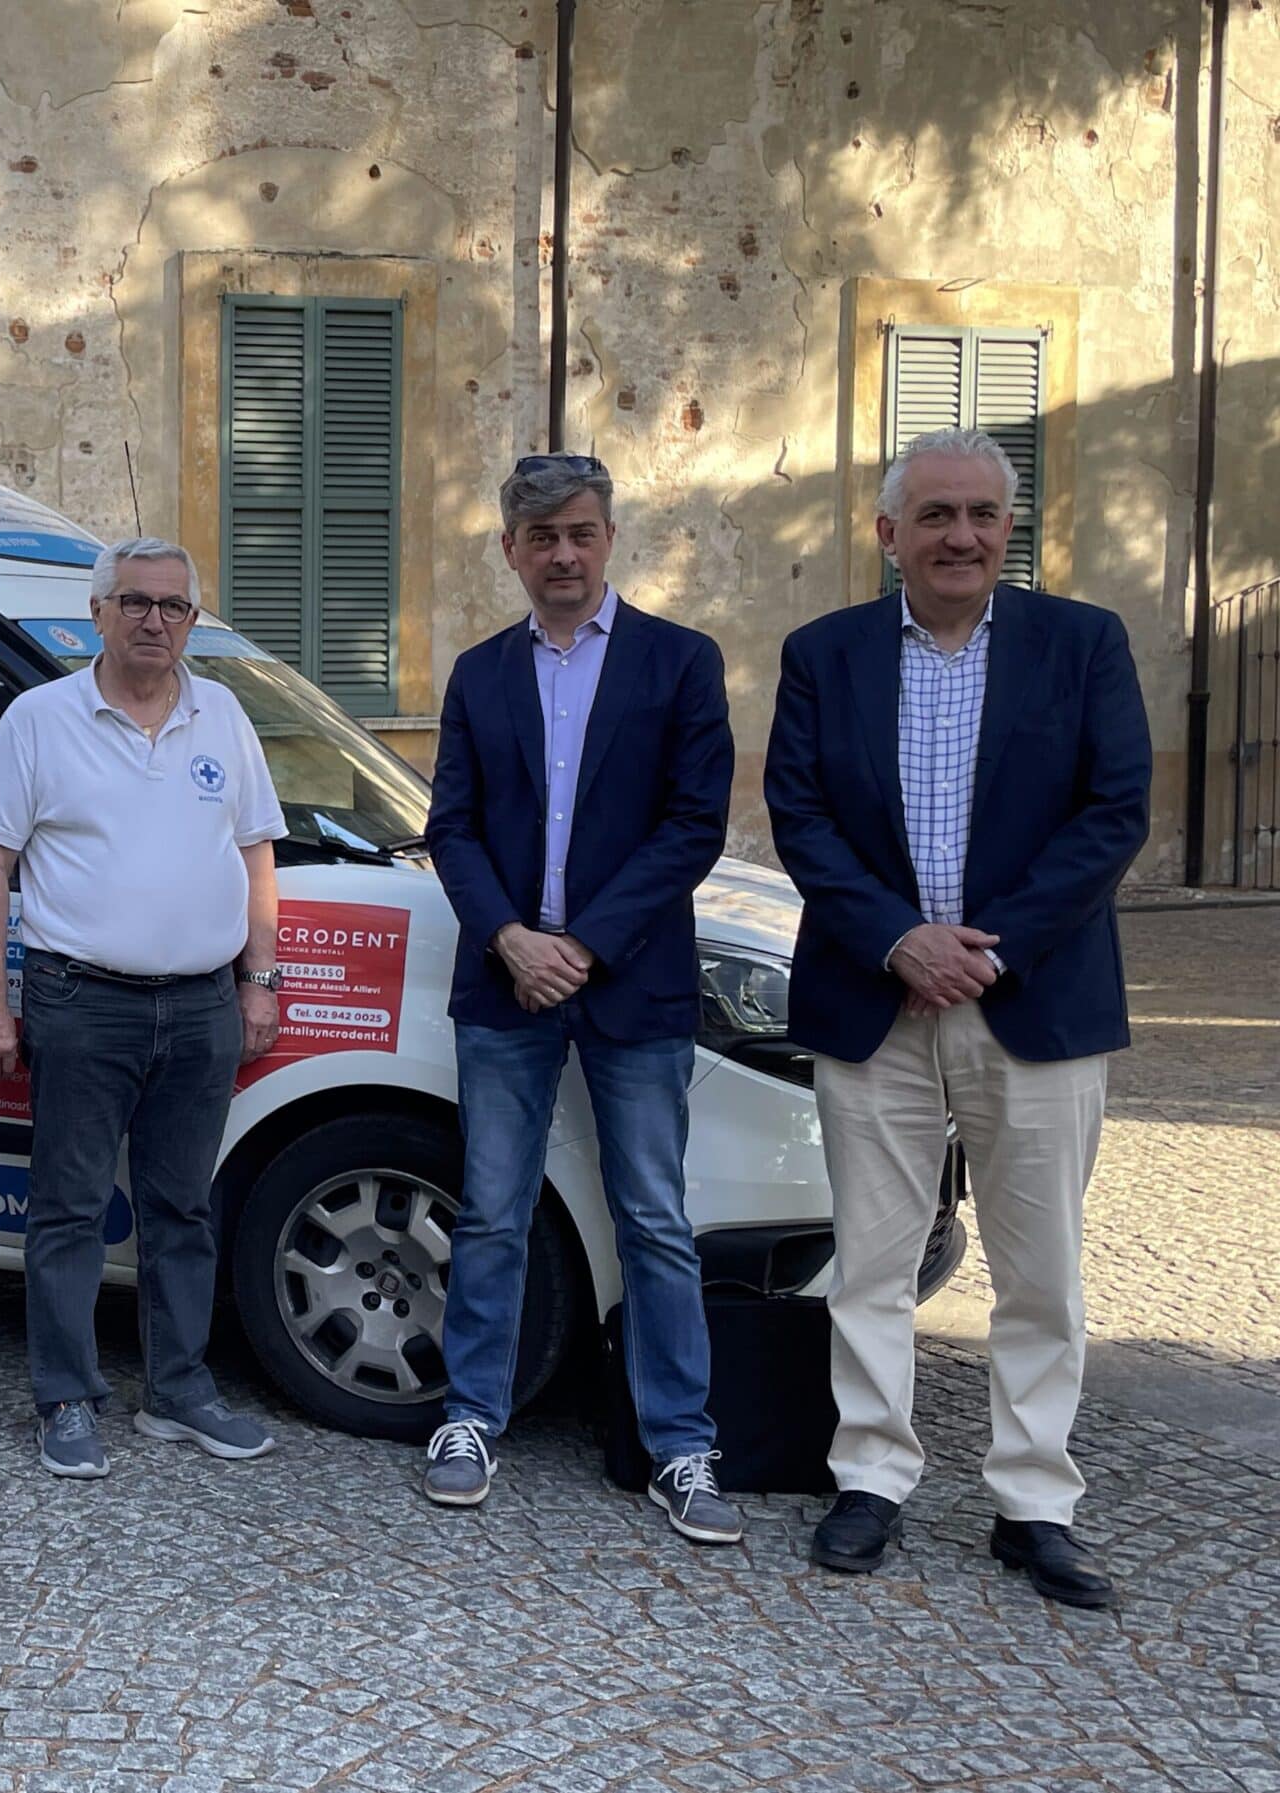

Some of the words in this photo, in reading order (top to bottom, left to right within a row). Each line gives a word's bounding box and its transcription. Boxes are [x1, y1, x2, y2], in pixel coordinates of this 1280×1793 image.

[278, 927, 399, 949] CRODENT
[312, 948, 345, 956] DENTALI
[280, 965, 344, 978] TEGRASSO
[284, 980, 318, 990] Dott.ssa
[320, 983, 351, 992] Alessia
[353, 985, 381, 994] Allievi
[295, 1008, 311, 1017] Tel.
[315, 1010, 328, 1019] 02
[331, 1011, 351, 1020] 942
[354, 1012, 382, 1023] 0025
[278, 1026, 389, 1042] ntalisyncrodent.it
